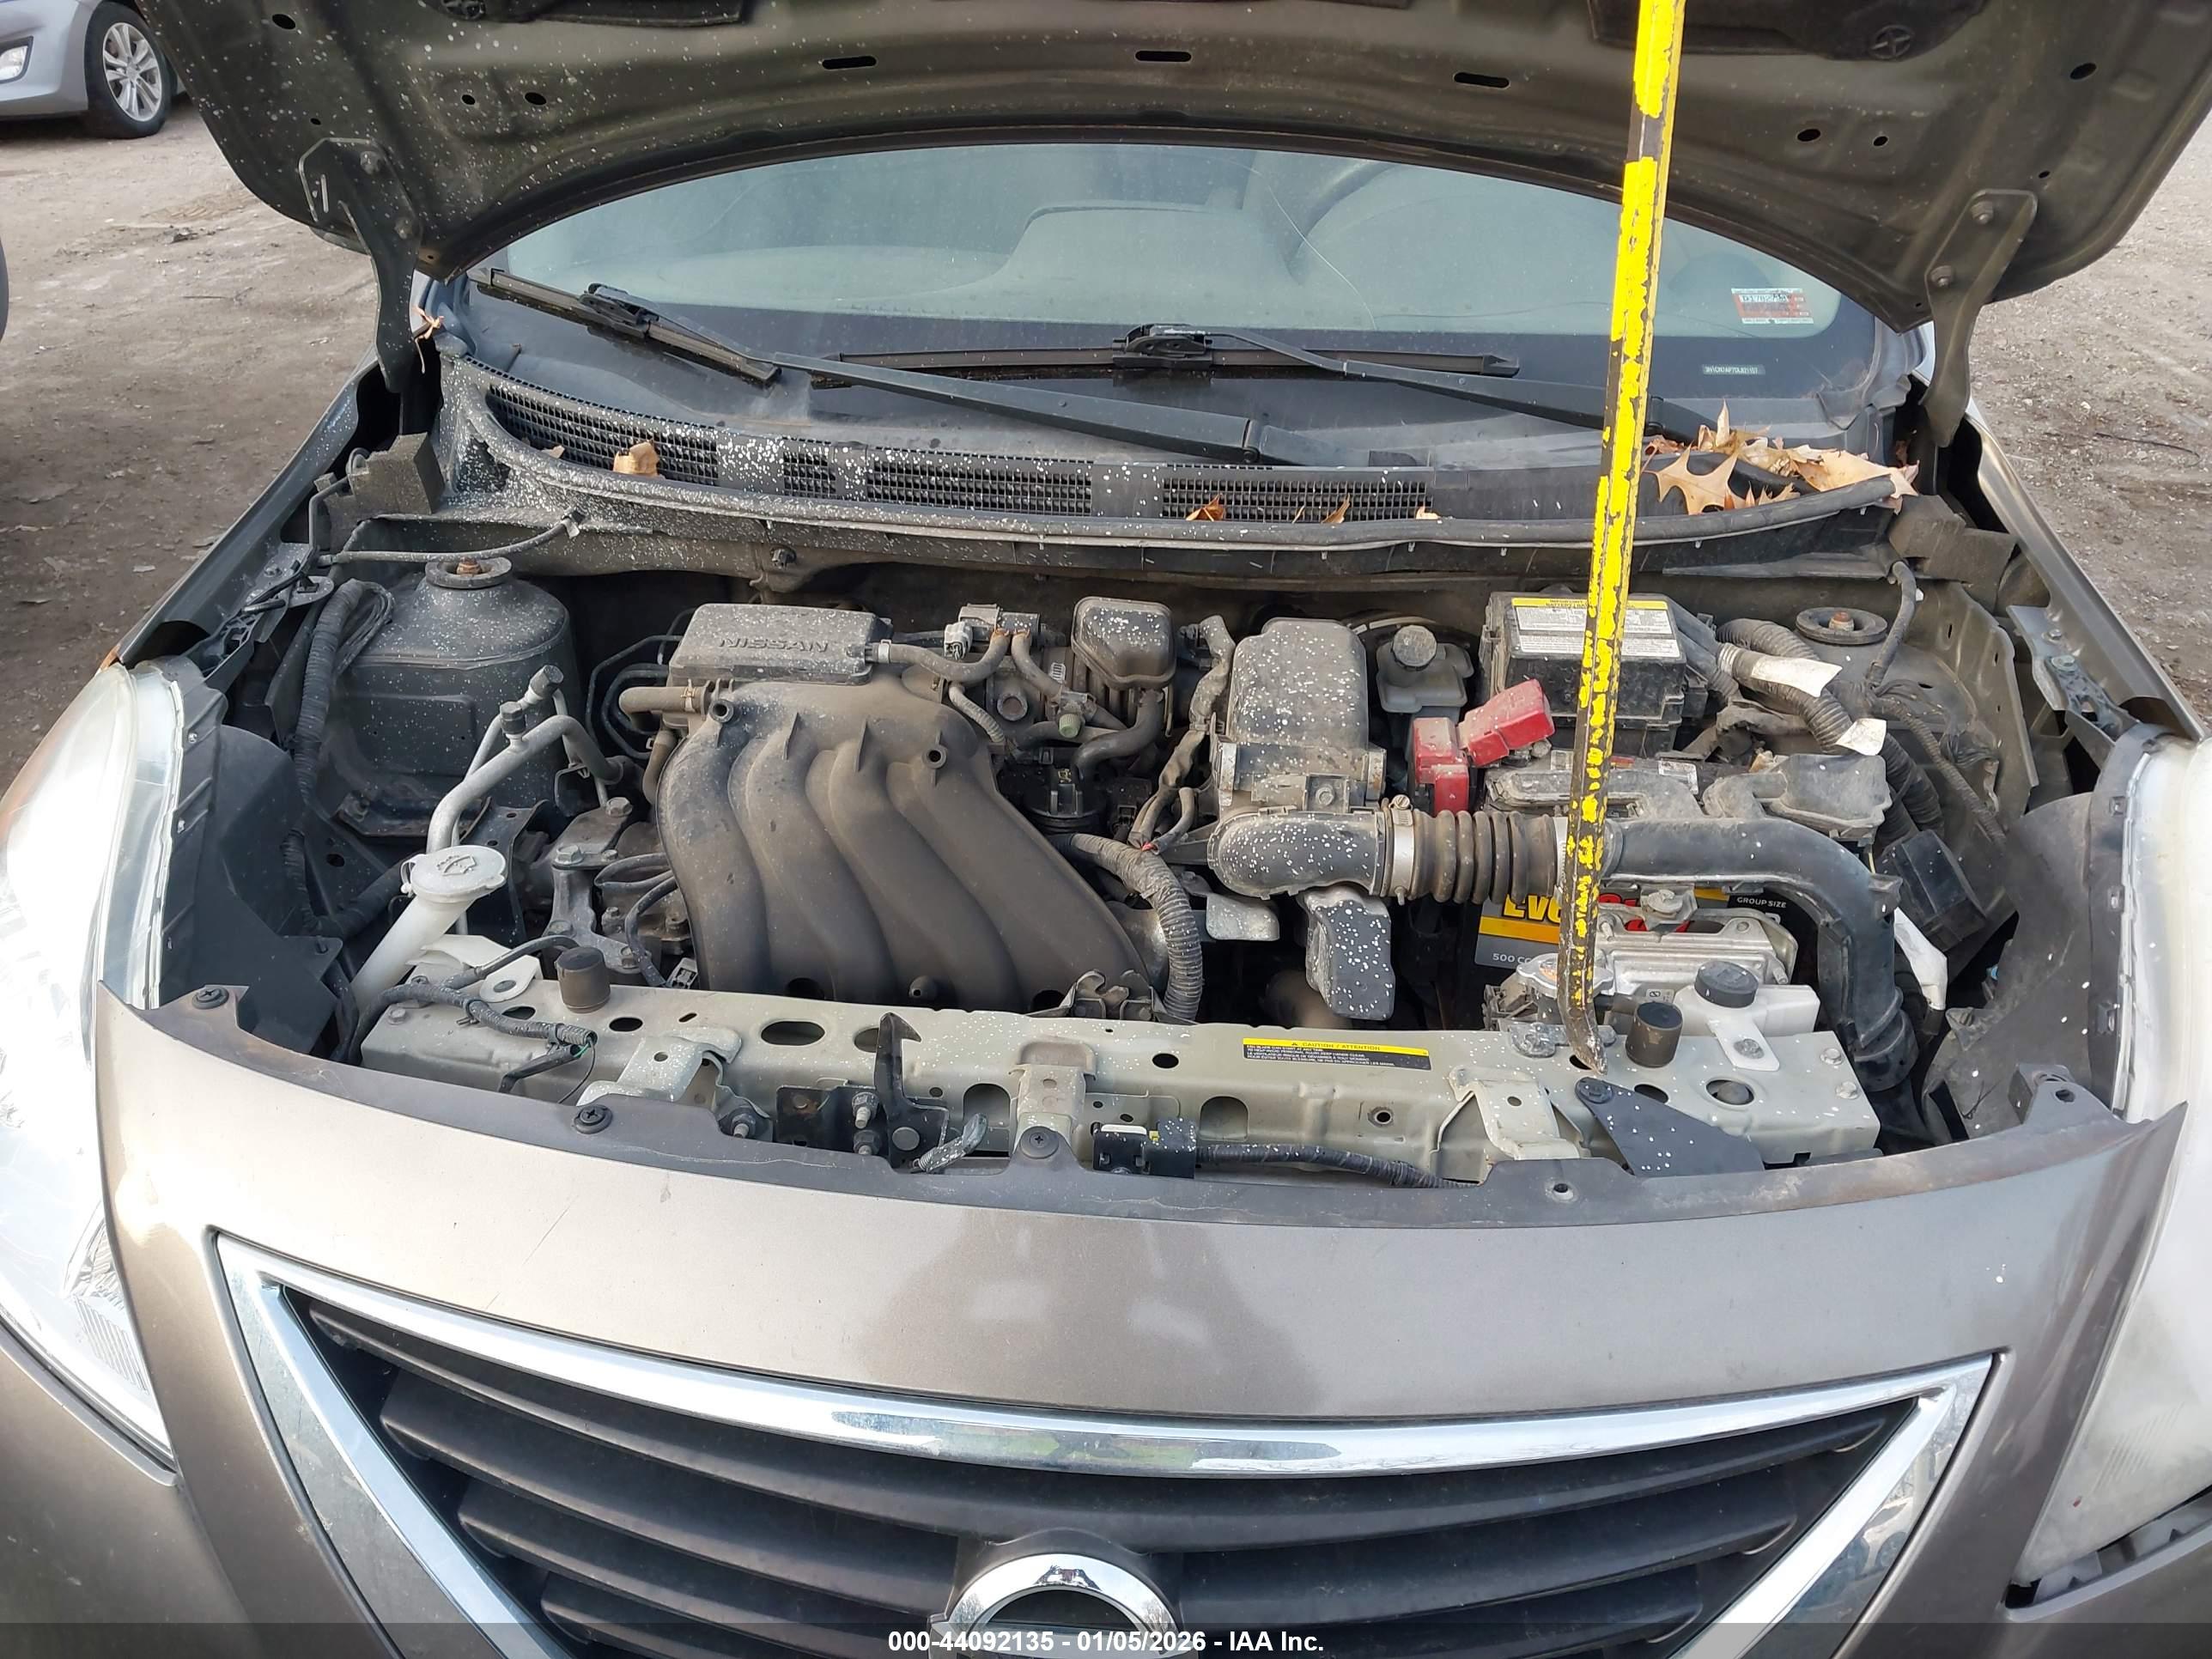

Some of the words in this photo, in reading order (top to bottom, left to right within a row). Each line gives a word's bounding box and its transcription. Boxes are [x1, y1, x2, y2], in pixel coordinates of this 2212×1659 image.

[719, 638, 829, 653] NISSAN
[1737, 896, 1766, 906] GROUP
[1767, 900, 1787, 908] SIZE
[1492, 952, 1516, 963] 500
